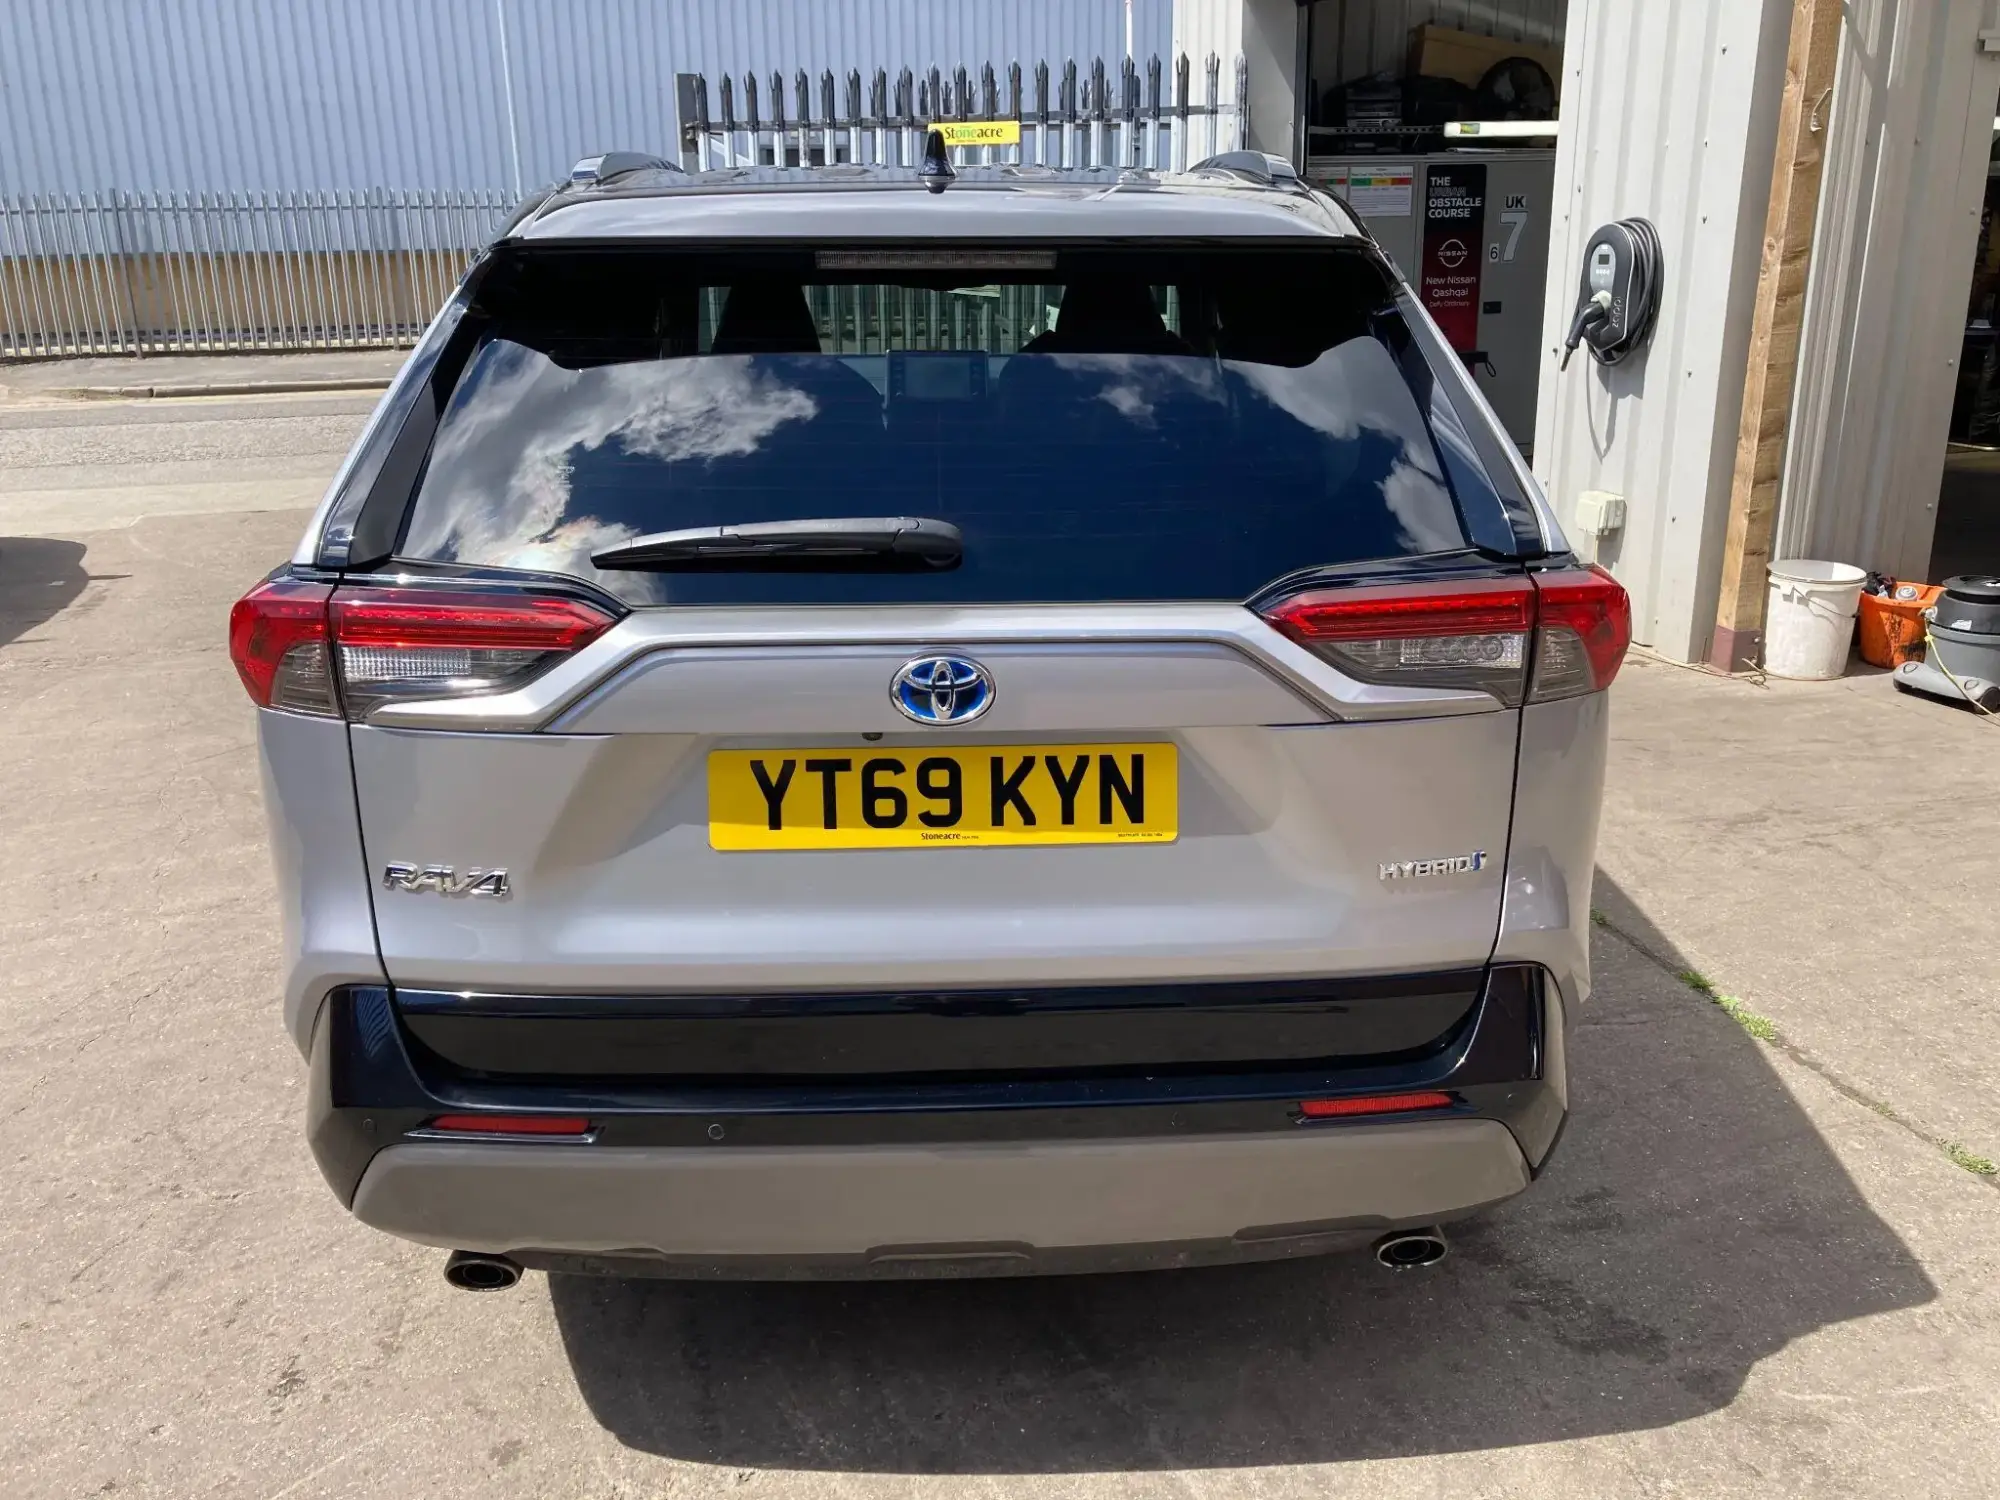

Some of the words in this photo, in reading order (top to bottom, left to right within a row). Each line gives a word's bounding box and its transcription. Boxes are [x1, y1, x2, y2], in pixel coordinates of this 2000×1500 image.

[944, 127, 1003, 140] Stoneacre
[1430, 177, 1451, 186] THE
[1429, 197, 1482, 208] OBSTACLE
[1505, 196, 1526, 209] UK
[1428, 208, 1471, 218] COURSE
[1500, 211, 1528, 262] 7
[1490, 246, 1499, 260] 6
[1425, 276, 1446, 285] New
[1447, 275, 1477, 285] Nissan
[1432, 287, 1469, 298] Qashqai
[749, 756, 963, 831] YT69
[990, 753, 1145, 827] KYN
[920, 832, 961, 841] Stoneacre
[1379, 856, 1472, 881] HYBRID
[382, 860, 510, 897] RAV4
